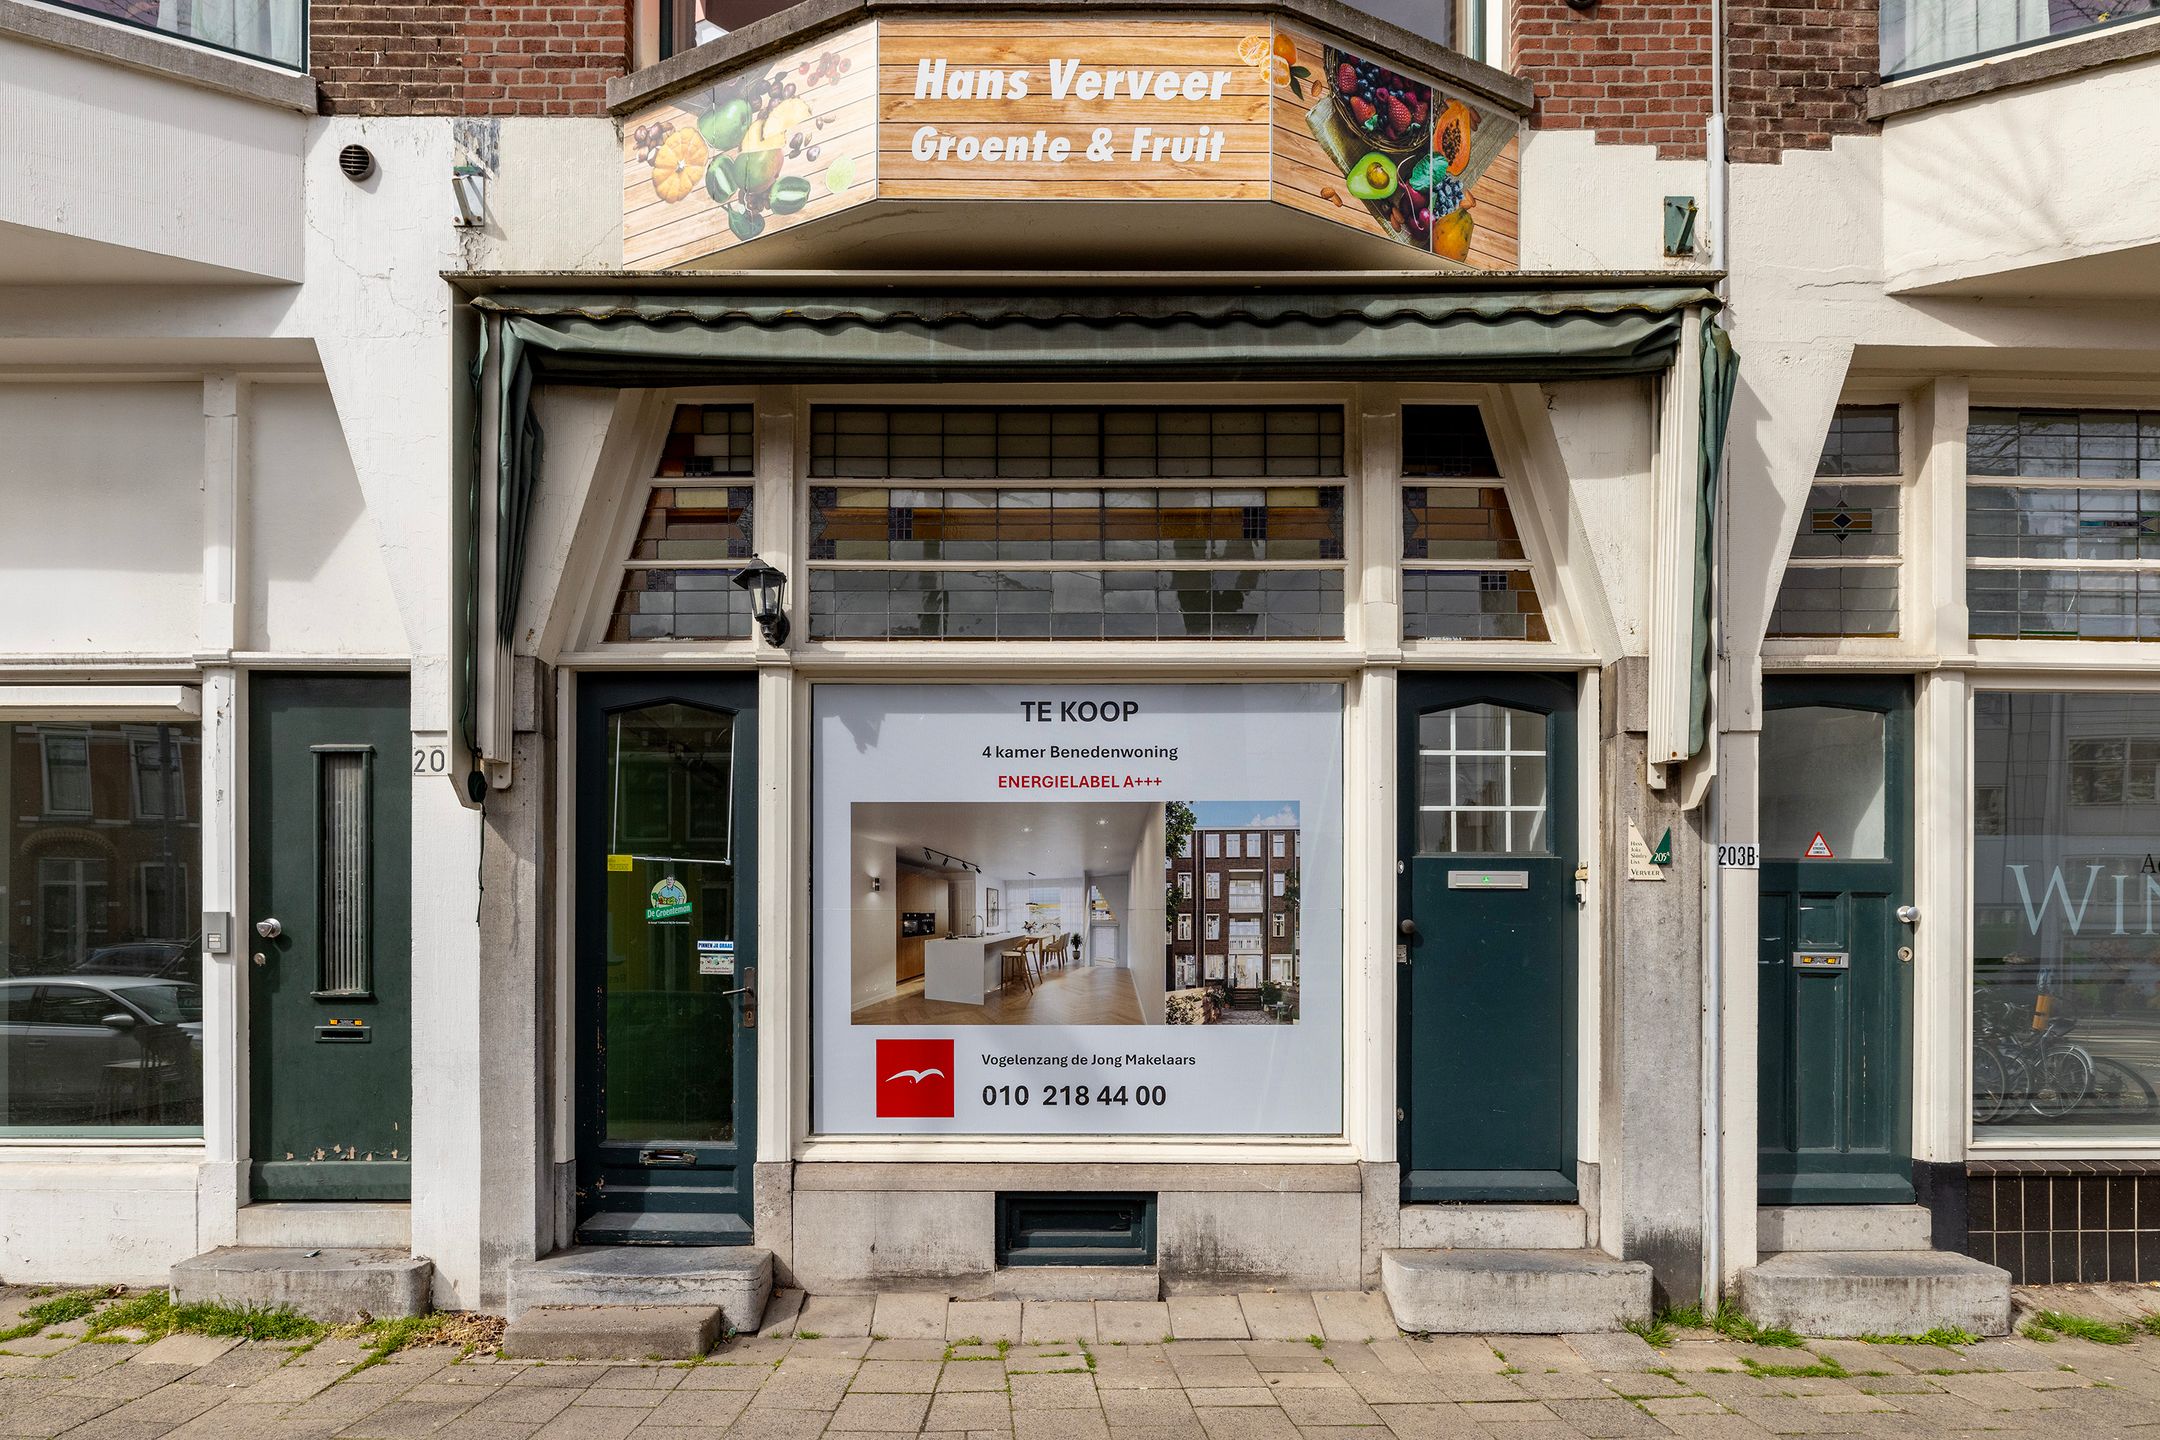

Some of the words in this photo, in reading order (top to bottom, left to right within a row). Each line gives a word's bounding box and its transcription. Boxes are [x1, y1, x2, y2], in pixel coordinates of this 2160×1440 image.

[914, 58, 1029, 101] Hans
[1050, 59, 1231, 101] Verveer
[911, 126, 1070, 163] Groente
[1084, 126, 1117, 163] &
[1131, 126, 1226, 163] Fruit
[1020, 701, 1052, 722] TE
[1061, 701, 1140, 722] KOOP
[982, 746, 992, 759] 4
[996, 745, 1047, 759] kamer
[1050, 745, 1178, 762] Benedenwoning
[998, 775, 1119, 789] ENERGIELABEL
[1123, 775, 1162, 789] A+++
[1718, 846, 1755, 866] 203B
[647, 909, 656, 919] De
[982, 1054, 1069, 1069] Vogelenzang
[1070, 1054, 1088, 1066] de
[1091, 1054, 1123, 1069] Jong
[1125, 1054, 1196, 1066] Makelaars
[982, 1086, 1029, 1106] 010
[1043, 1086, 1090, 1106] 218
[1097, 1086, 1129, 1106] 44
[1135, 1086, 1166, 1106] 00
